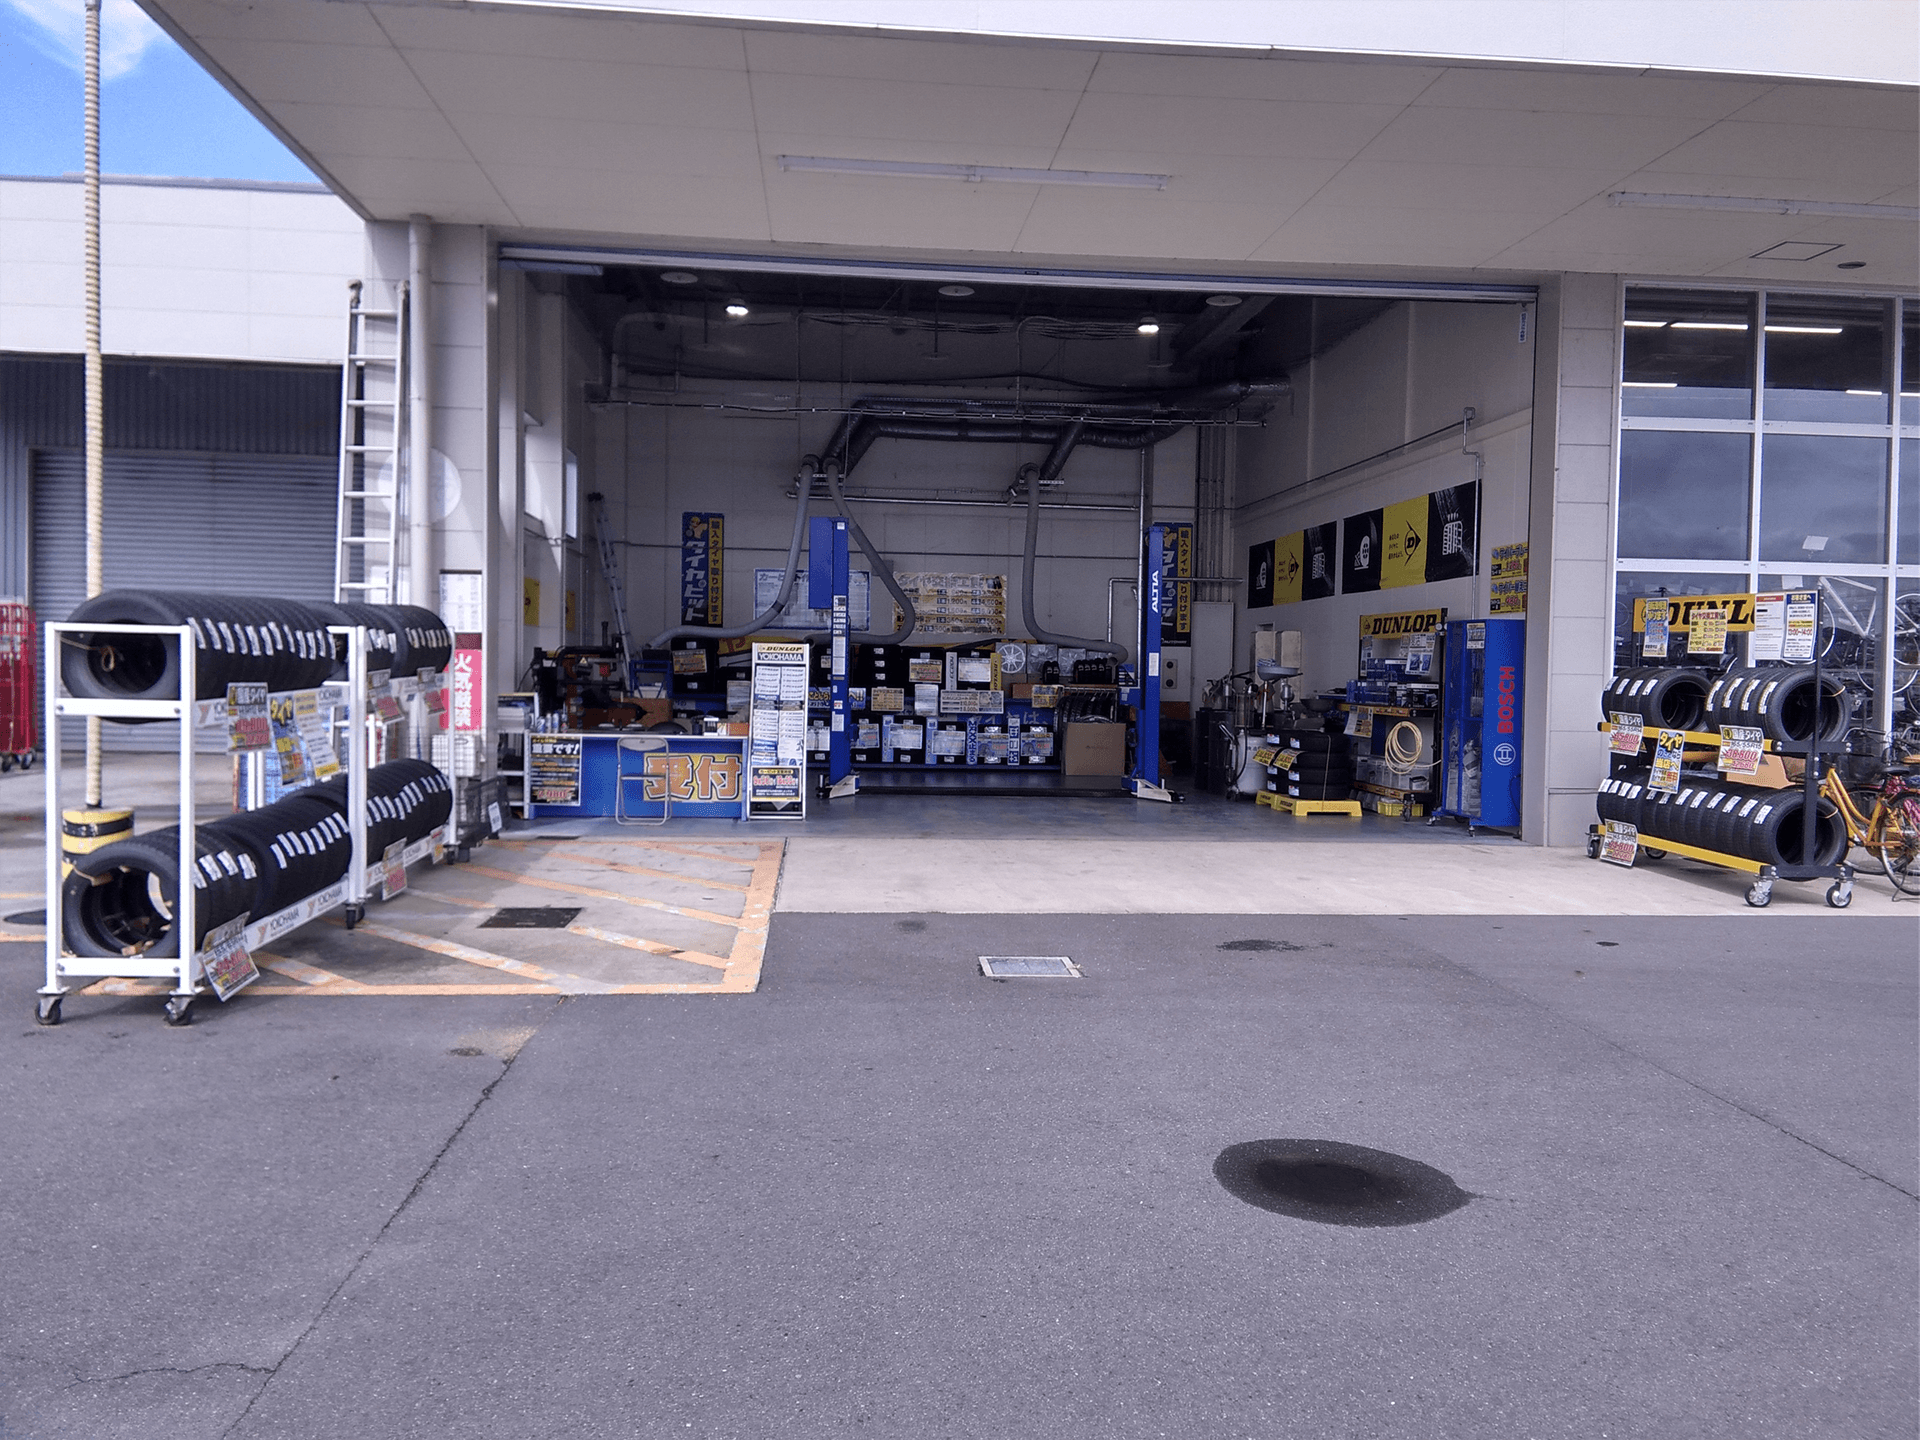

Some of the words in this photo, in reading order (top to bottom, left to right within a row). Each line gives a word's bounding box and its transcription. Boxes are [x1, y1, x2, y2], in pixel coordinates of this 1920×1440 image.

[683, 540, 706, 622] タイヤピット
[1151, 570, 1159, 614] ALTIA
[1371, 613, 1438, 635] DUNLOP
[758, 653, 803, 661] YOKOHAMA
[1497, 666, 1515, 734] BOSCH
[1660, 731, 1684, 751] タイヤ
[1731, 728, 1762, 742] 国産タイヤ
[645, 755, 742, 800] 受付
[270, 906, 299, 930] YOKOHAMA
